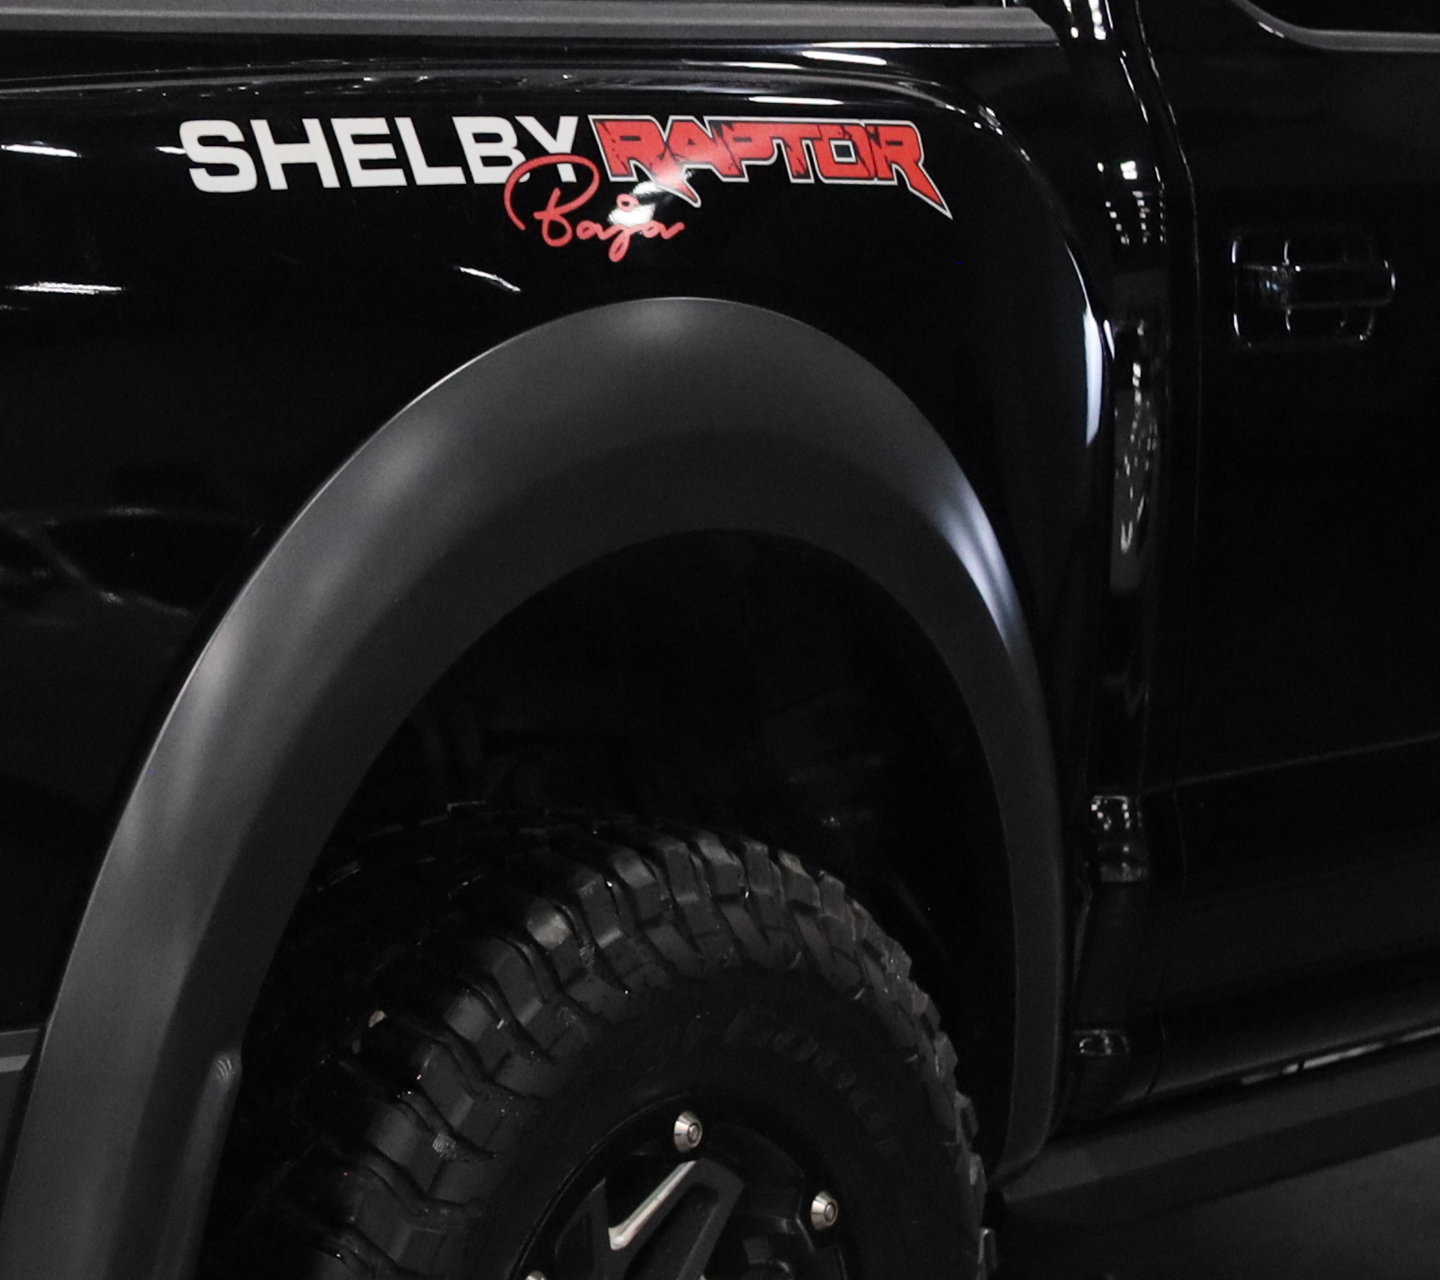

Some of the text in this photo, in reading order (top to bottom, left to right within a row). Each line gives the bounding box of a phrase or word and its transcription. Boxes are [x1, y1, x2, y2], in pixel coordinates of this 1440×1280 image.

[178, 114, 953, 221] SHELBY RAPTOR
[503, 153, 687, 262] Baja
